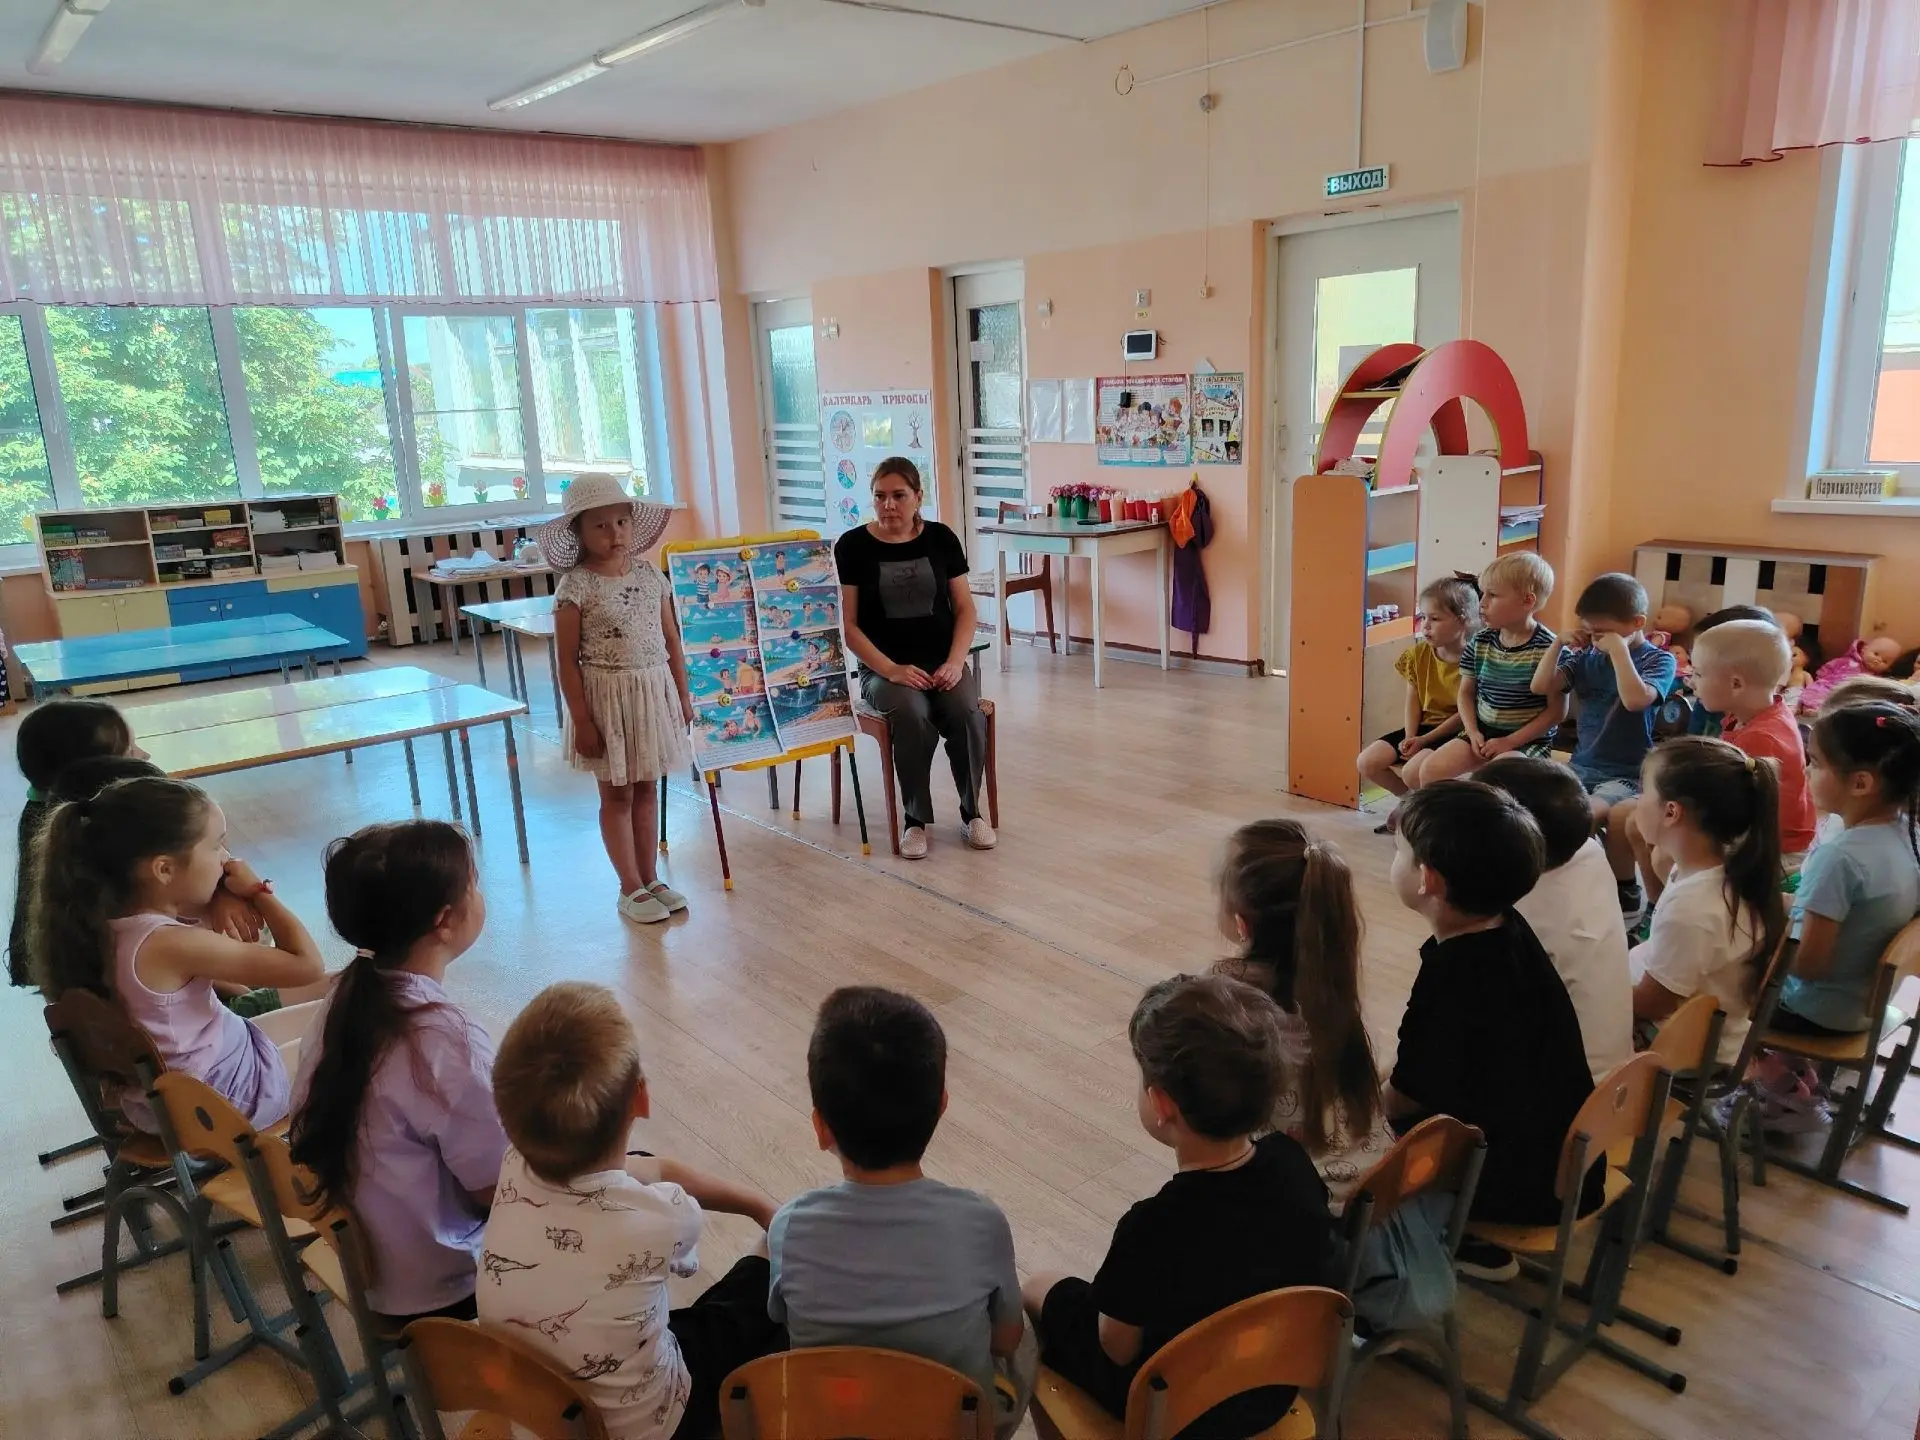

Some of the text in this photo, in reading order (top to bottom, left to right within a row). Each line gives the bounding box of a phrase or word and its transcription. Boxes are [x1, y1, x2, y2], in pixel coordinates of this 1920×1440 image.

[1330, 171, 1382, 193] ВЫХОД
[823, 393, 928, 407] КАЛЕНДАРЬ ПРИРОДЫ
[1816, 478, 1882, 498] Парикмахерская
